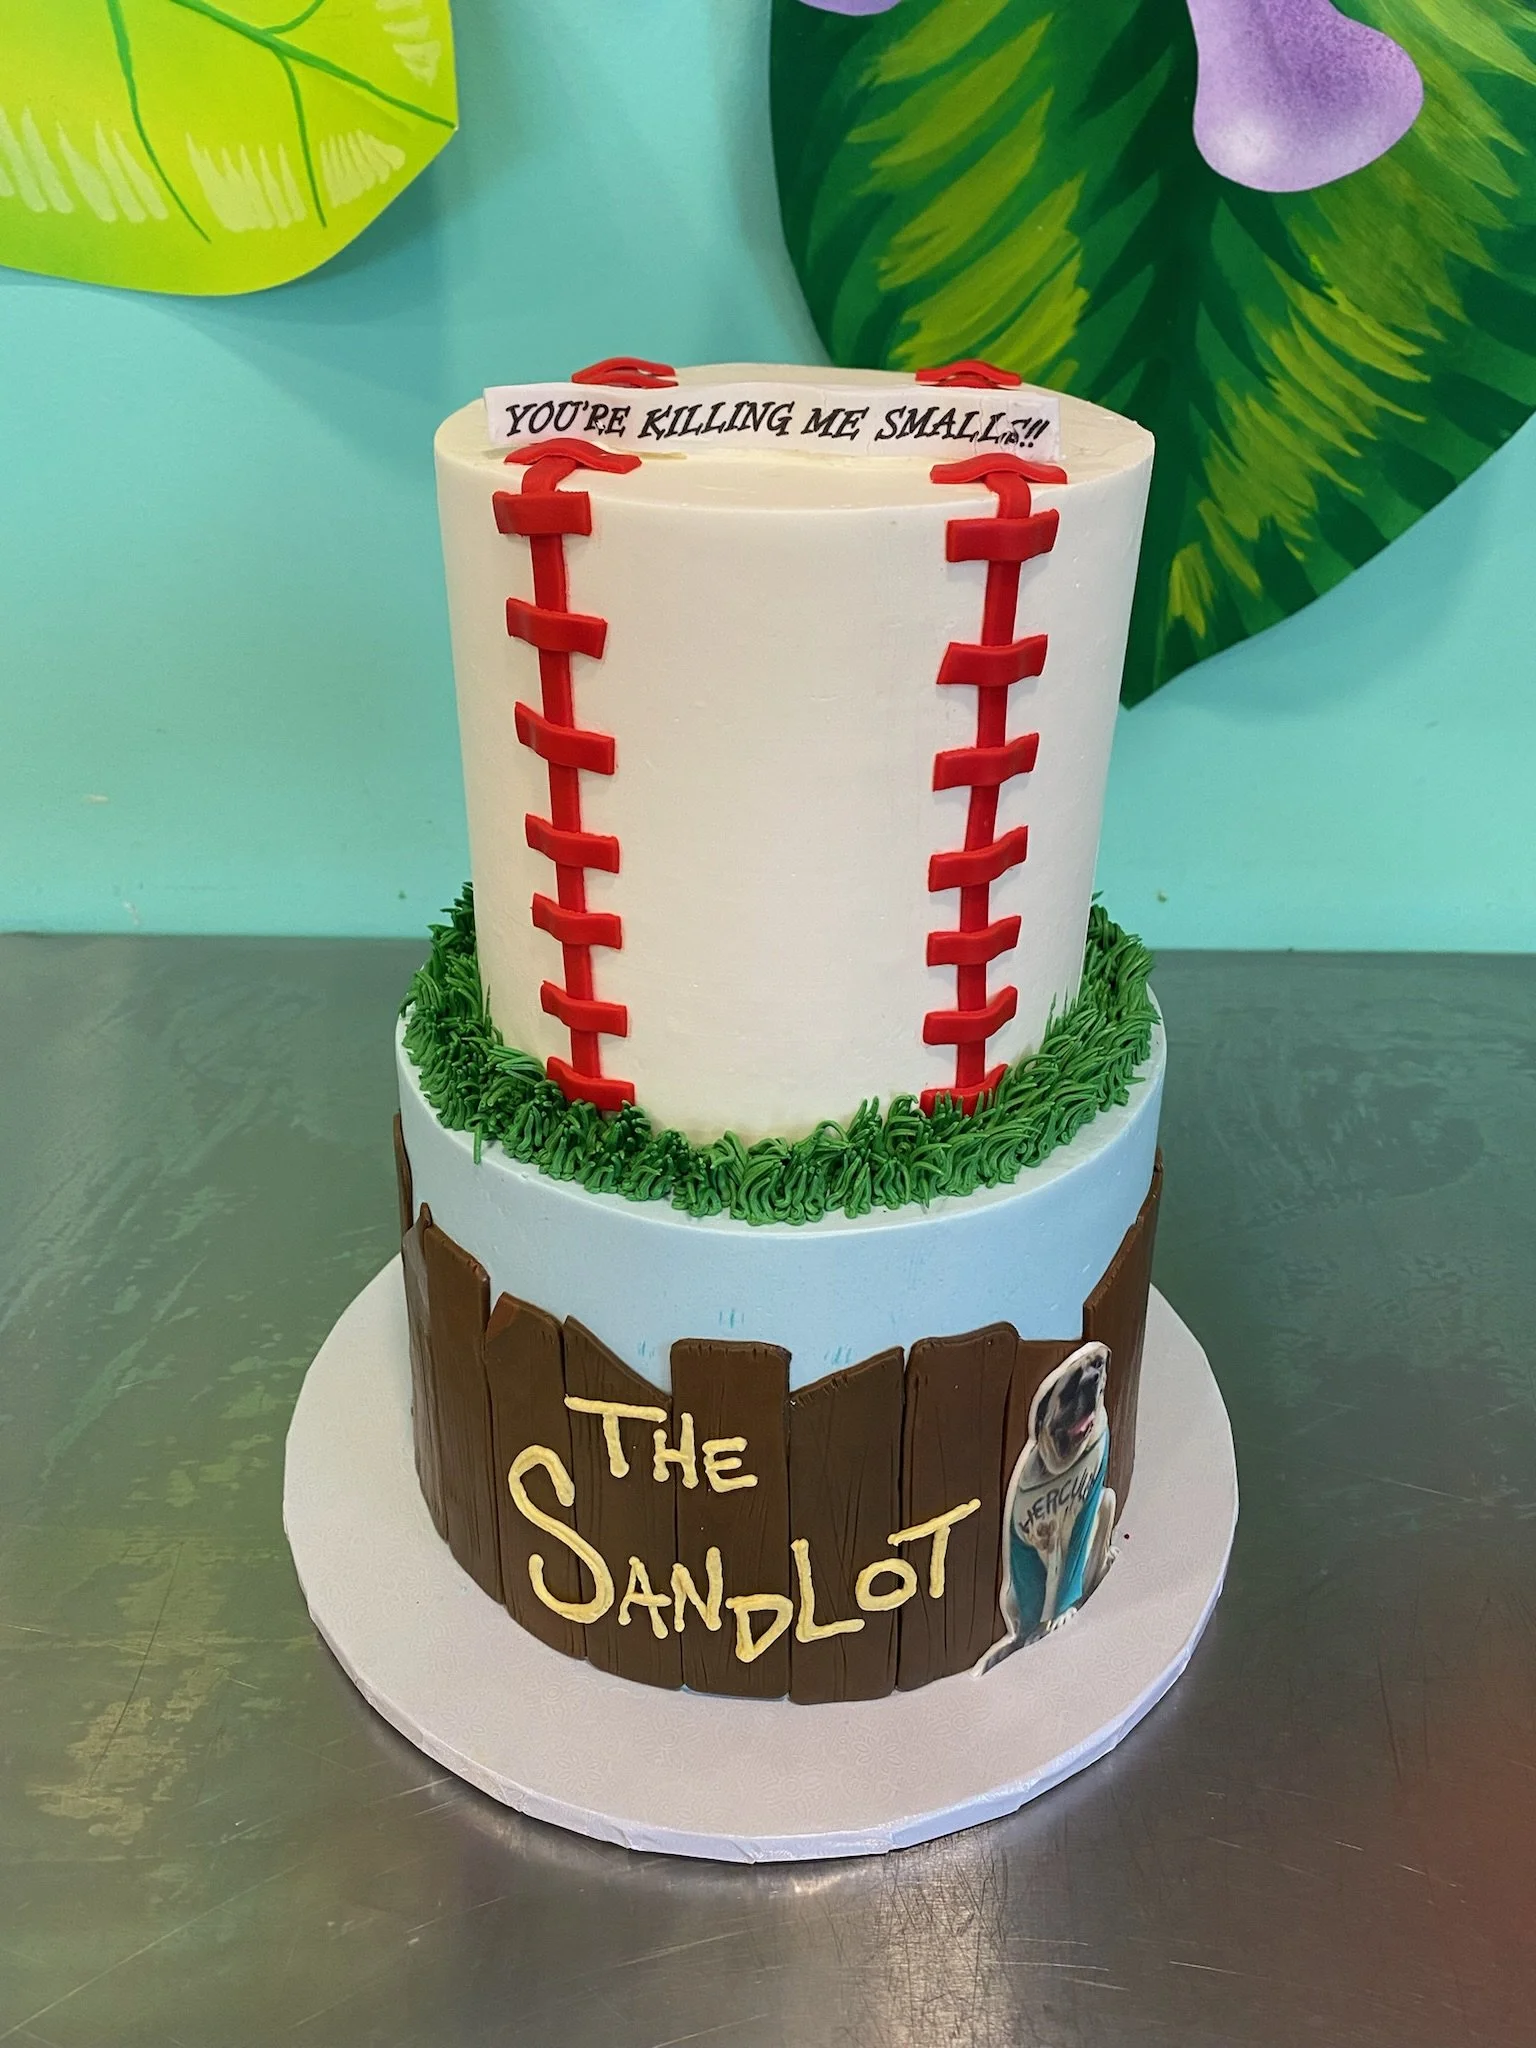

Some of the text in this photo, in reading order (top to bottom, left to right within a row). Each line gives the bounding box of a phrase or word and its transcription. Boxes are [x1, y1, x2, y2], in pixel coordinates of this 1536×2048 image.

[506, 400, 631, 438] YOU'RE
[637, 400, 795, 441] KILLING
[800, 406, 870, 441] ME
[564, 1396, 758, 1493] THE
[508, 1444, 981, 1663] SANDLOT
